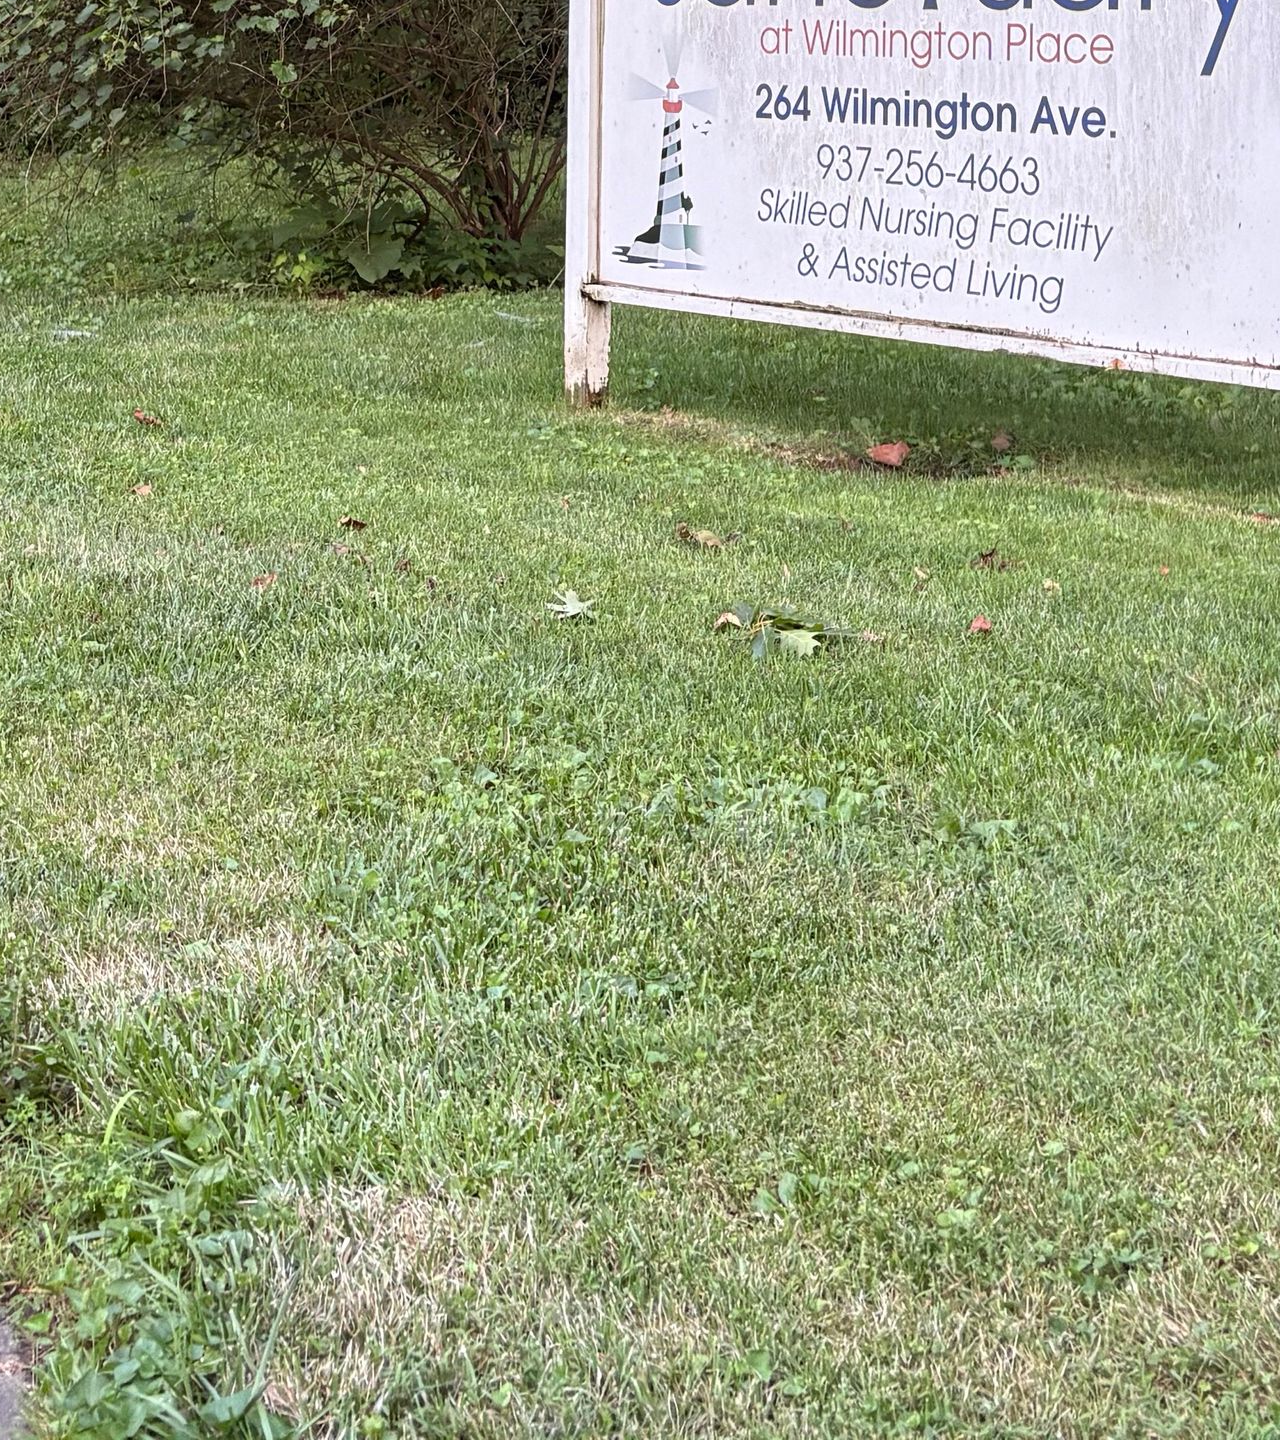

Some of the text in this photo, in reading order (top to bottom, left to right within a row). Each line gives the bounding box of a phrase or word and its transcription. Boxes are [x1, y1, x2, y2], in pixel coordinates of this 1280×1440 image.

[759, 19, 1115, 69] at Wilmington Place
[756, 84, 1117, 139] 264 Wilmington Ave.
[818, 144, 1040, 196] 937-256-4663
[758, 188, 1113, 261] Skilled Nursing Facility
[798, 243, 1064, 312] & Assisted Living
